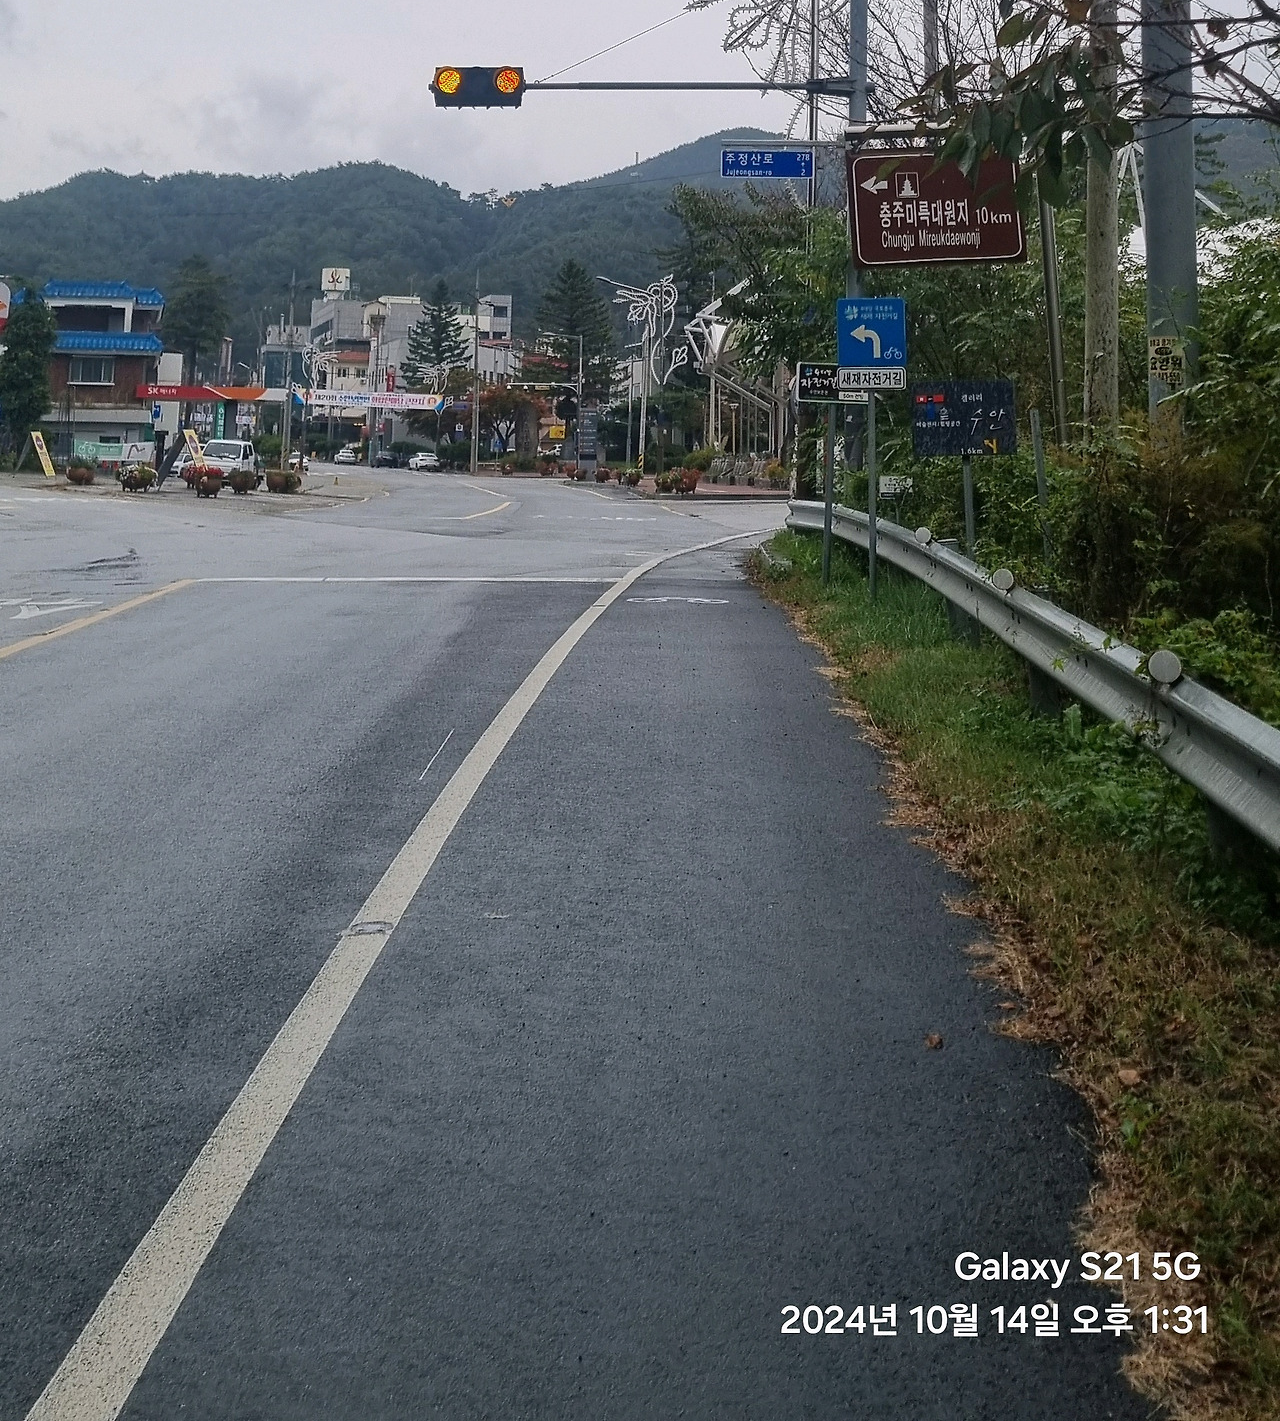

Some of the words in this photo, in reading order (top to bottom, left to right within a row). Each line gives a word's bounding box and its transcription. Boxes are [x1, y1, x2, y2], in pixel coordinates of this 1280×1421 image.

[725, 153, 774, 166] 주정산로
[796, 153, 810, 161] 278
[725, 168, 773, 177] Jujeongsan-ro
[800, 168, 806, 176] 2
[880, 198, 969, 228] 충주미륵대원지
[881, 230, 915, 252] Chungju
[918, 228, 981, 249] Mireukdaewonji
[841, 371, 902, 386] 새재자전거길
[147, 387, 159, 395] SK
[960, 447, 983, 455] 1.6km
